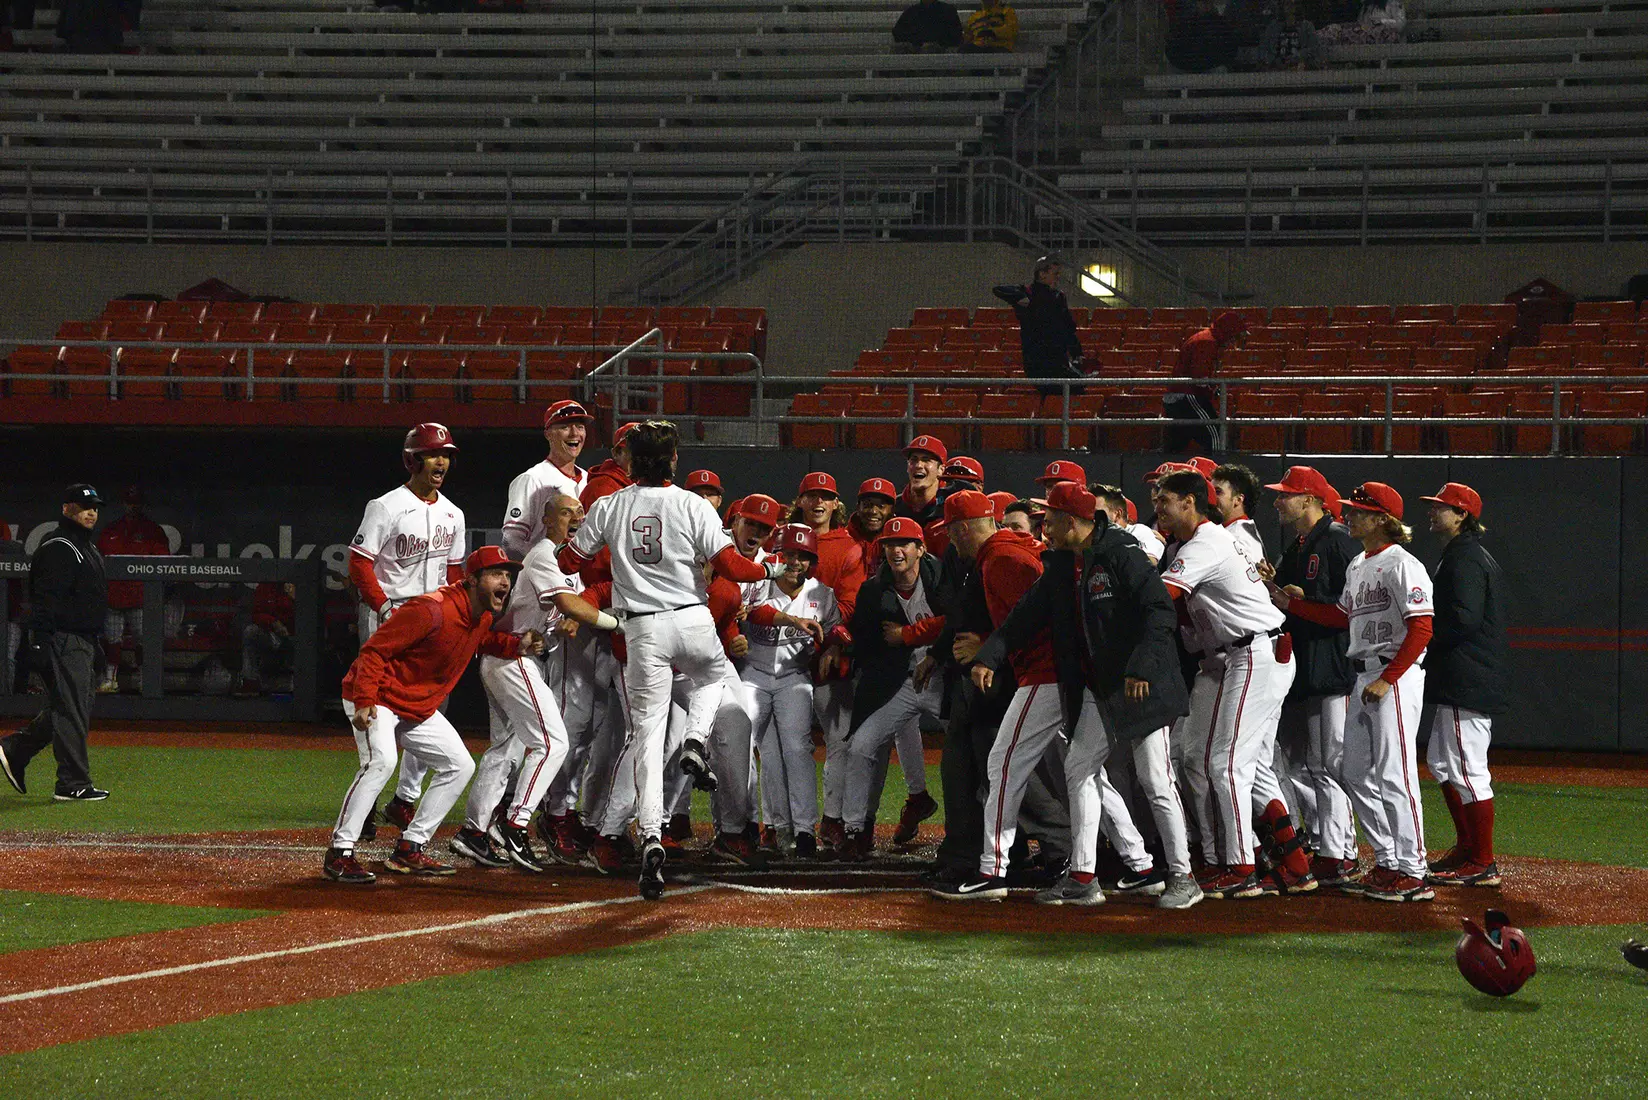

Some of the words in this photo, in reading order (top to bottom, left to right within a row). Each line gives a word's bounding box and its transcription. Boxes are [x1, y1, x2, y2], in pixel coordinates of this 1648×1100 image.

[437, 429, 447, 441] O
[918, 437, 928, 447] O
[1051, 463, 1061, 475] O
[701, 471, 710, 483] O
[818, 474, 827, 485] O
[873, 479, 882, 491] O
[760, 501, 769, 513] O
[892, 520, 901, 532] O
[632, 516, 662, 564] 3
[796, 531, 805, 543] O
[395, 533, 429, 558] Ohio
[126, 564, 154, 574] OHIO
[157, 565, 187, 575] STATE
[190, 566, 242, 575] BASEBALL
[1305, 553, 1320, 580] O
[1356, 580, 1393, 609] State
[1361, 620, 1393, 645] 42
